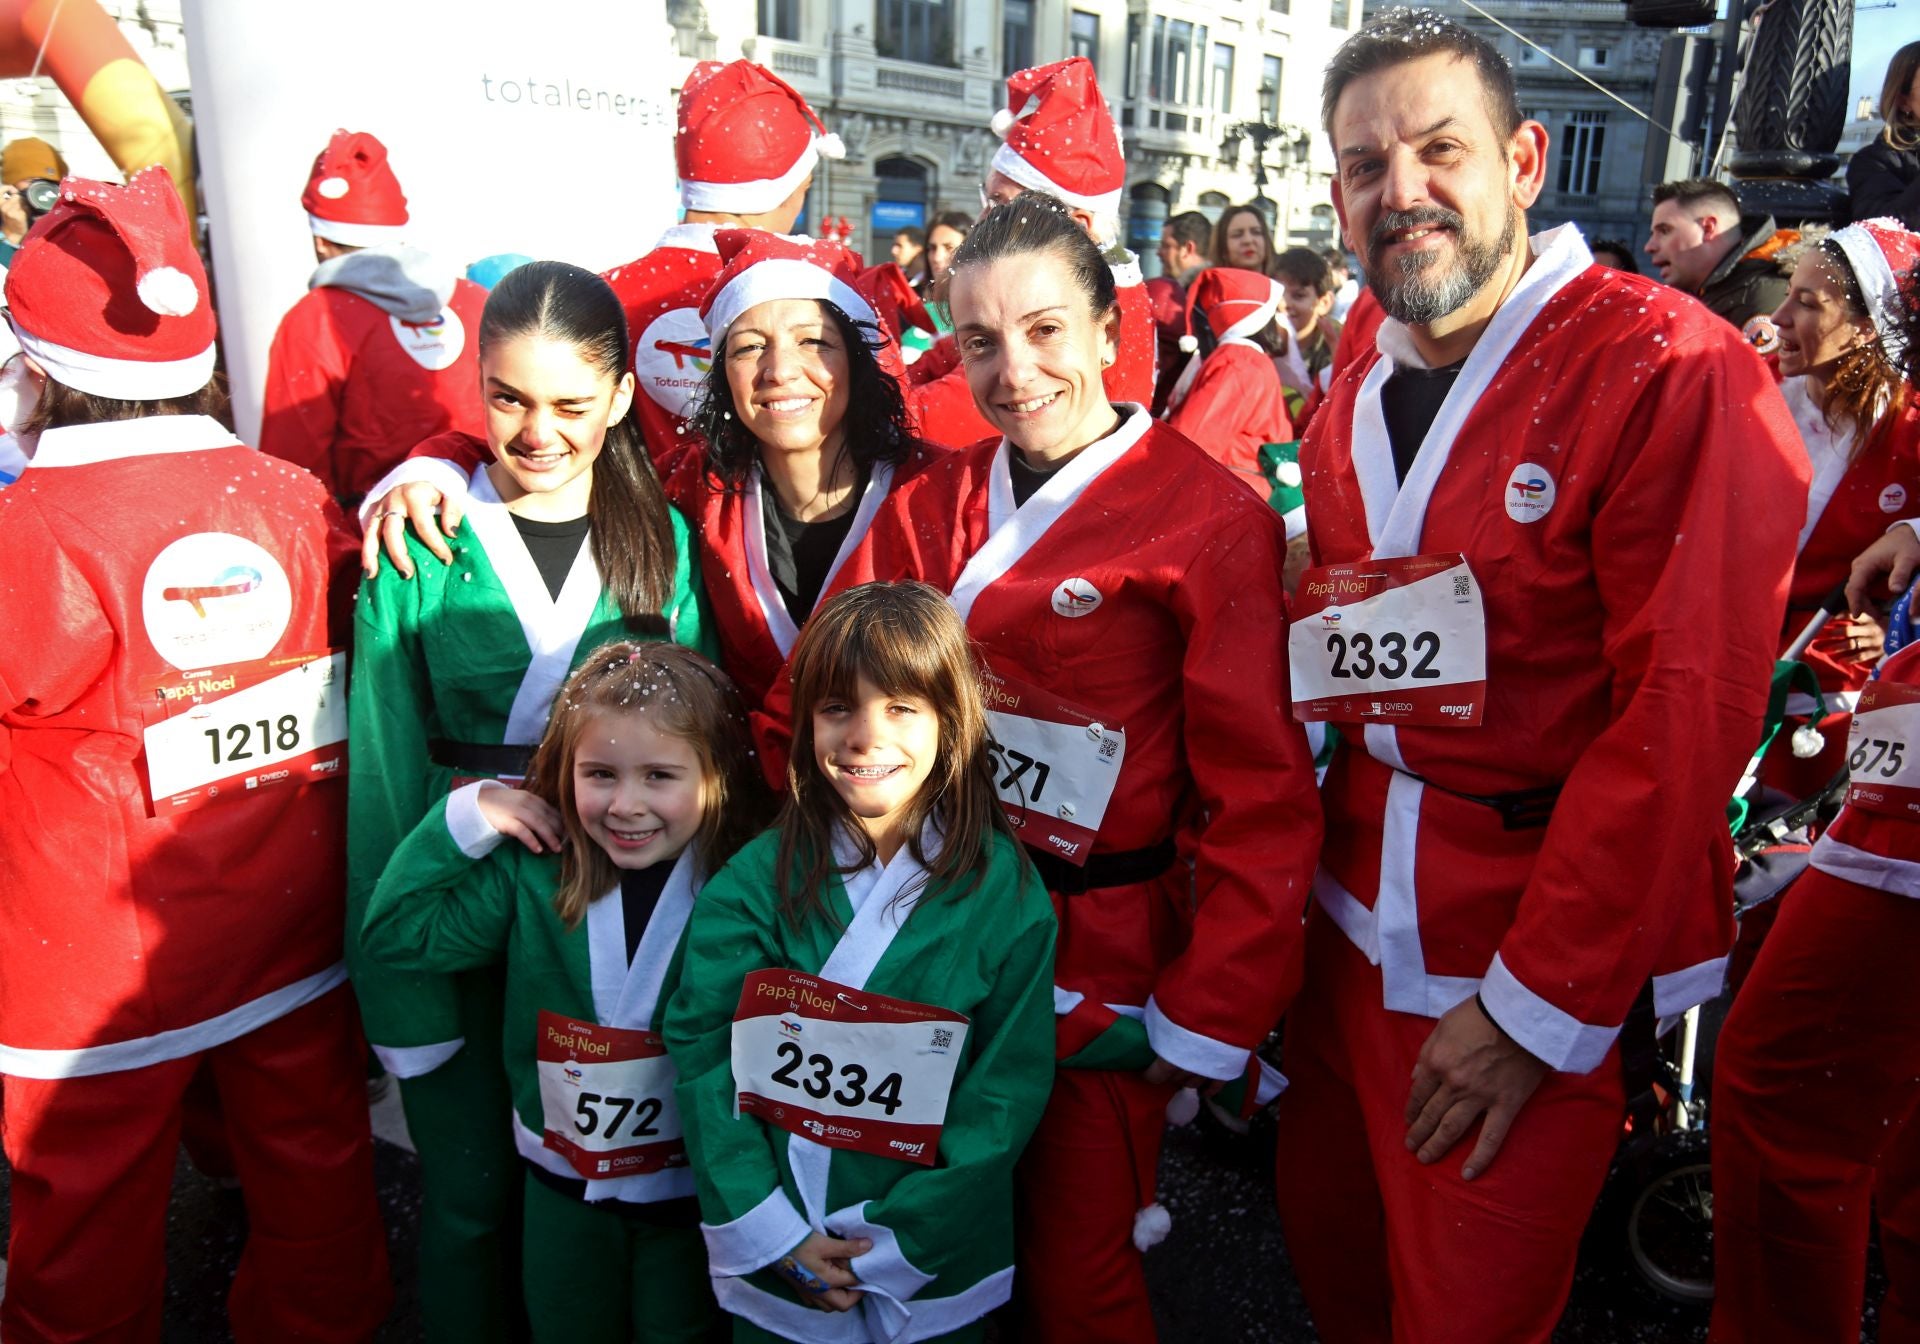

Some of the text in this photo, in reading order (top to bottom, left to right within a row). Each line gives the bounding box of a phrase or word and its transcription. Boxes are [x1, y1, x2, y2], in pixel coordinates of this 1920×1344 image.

[1329, 568, 1354, 577] Carrera
[1306, 578, 1369, 596] Papá Noel
[1329, 594, 1340, 604] by
[1326, 631, 1441, 680] 2332
[198, 674, 236, 695] Noel
[1384, 702, 1413, 712] OVIEDO
[1439, 702, 1473, 716] enjoy!
[204, 714, 301, 765] 1218
[1849, 737, 1905, 778] 675
[259, 769, 289, 783] OVIEDO
[1861, 790, 1884, 802] OVIEDO
[1048, 833, 1080, 855] enjoy!
[788, 974, 819, 989] Carrera
[756, 982, 837, 1014] Papá Noel
[789, 1001, 800, 1012] by
[568, 1022, 593, 1036] Carrera
[547, 1026, 611, 1057] Papá Noel
[569, 1050, 578, 1060] by
[771, 1041, 903, 1116] 2334
[574, 1092, 663, 1140] 572
[828, 1124, 862, 1139] OVIEDO
[889, 1140, 926, 1155] enjoy!
[613, 1155, 645, 1167] OVIEDO
